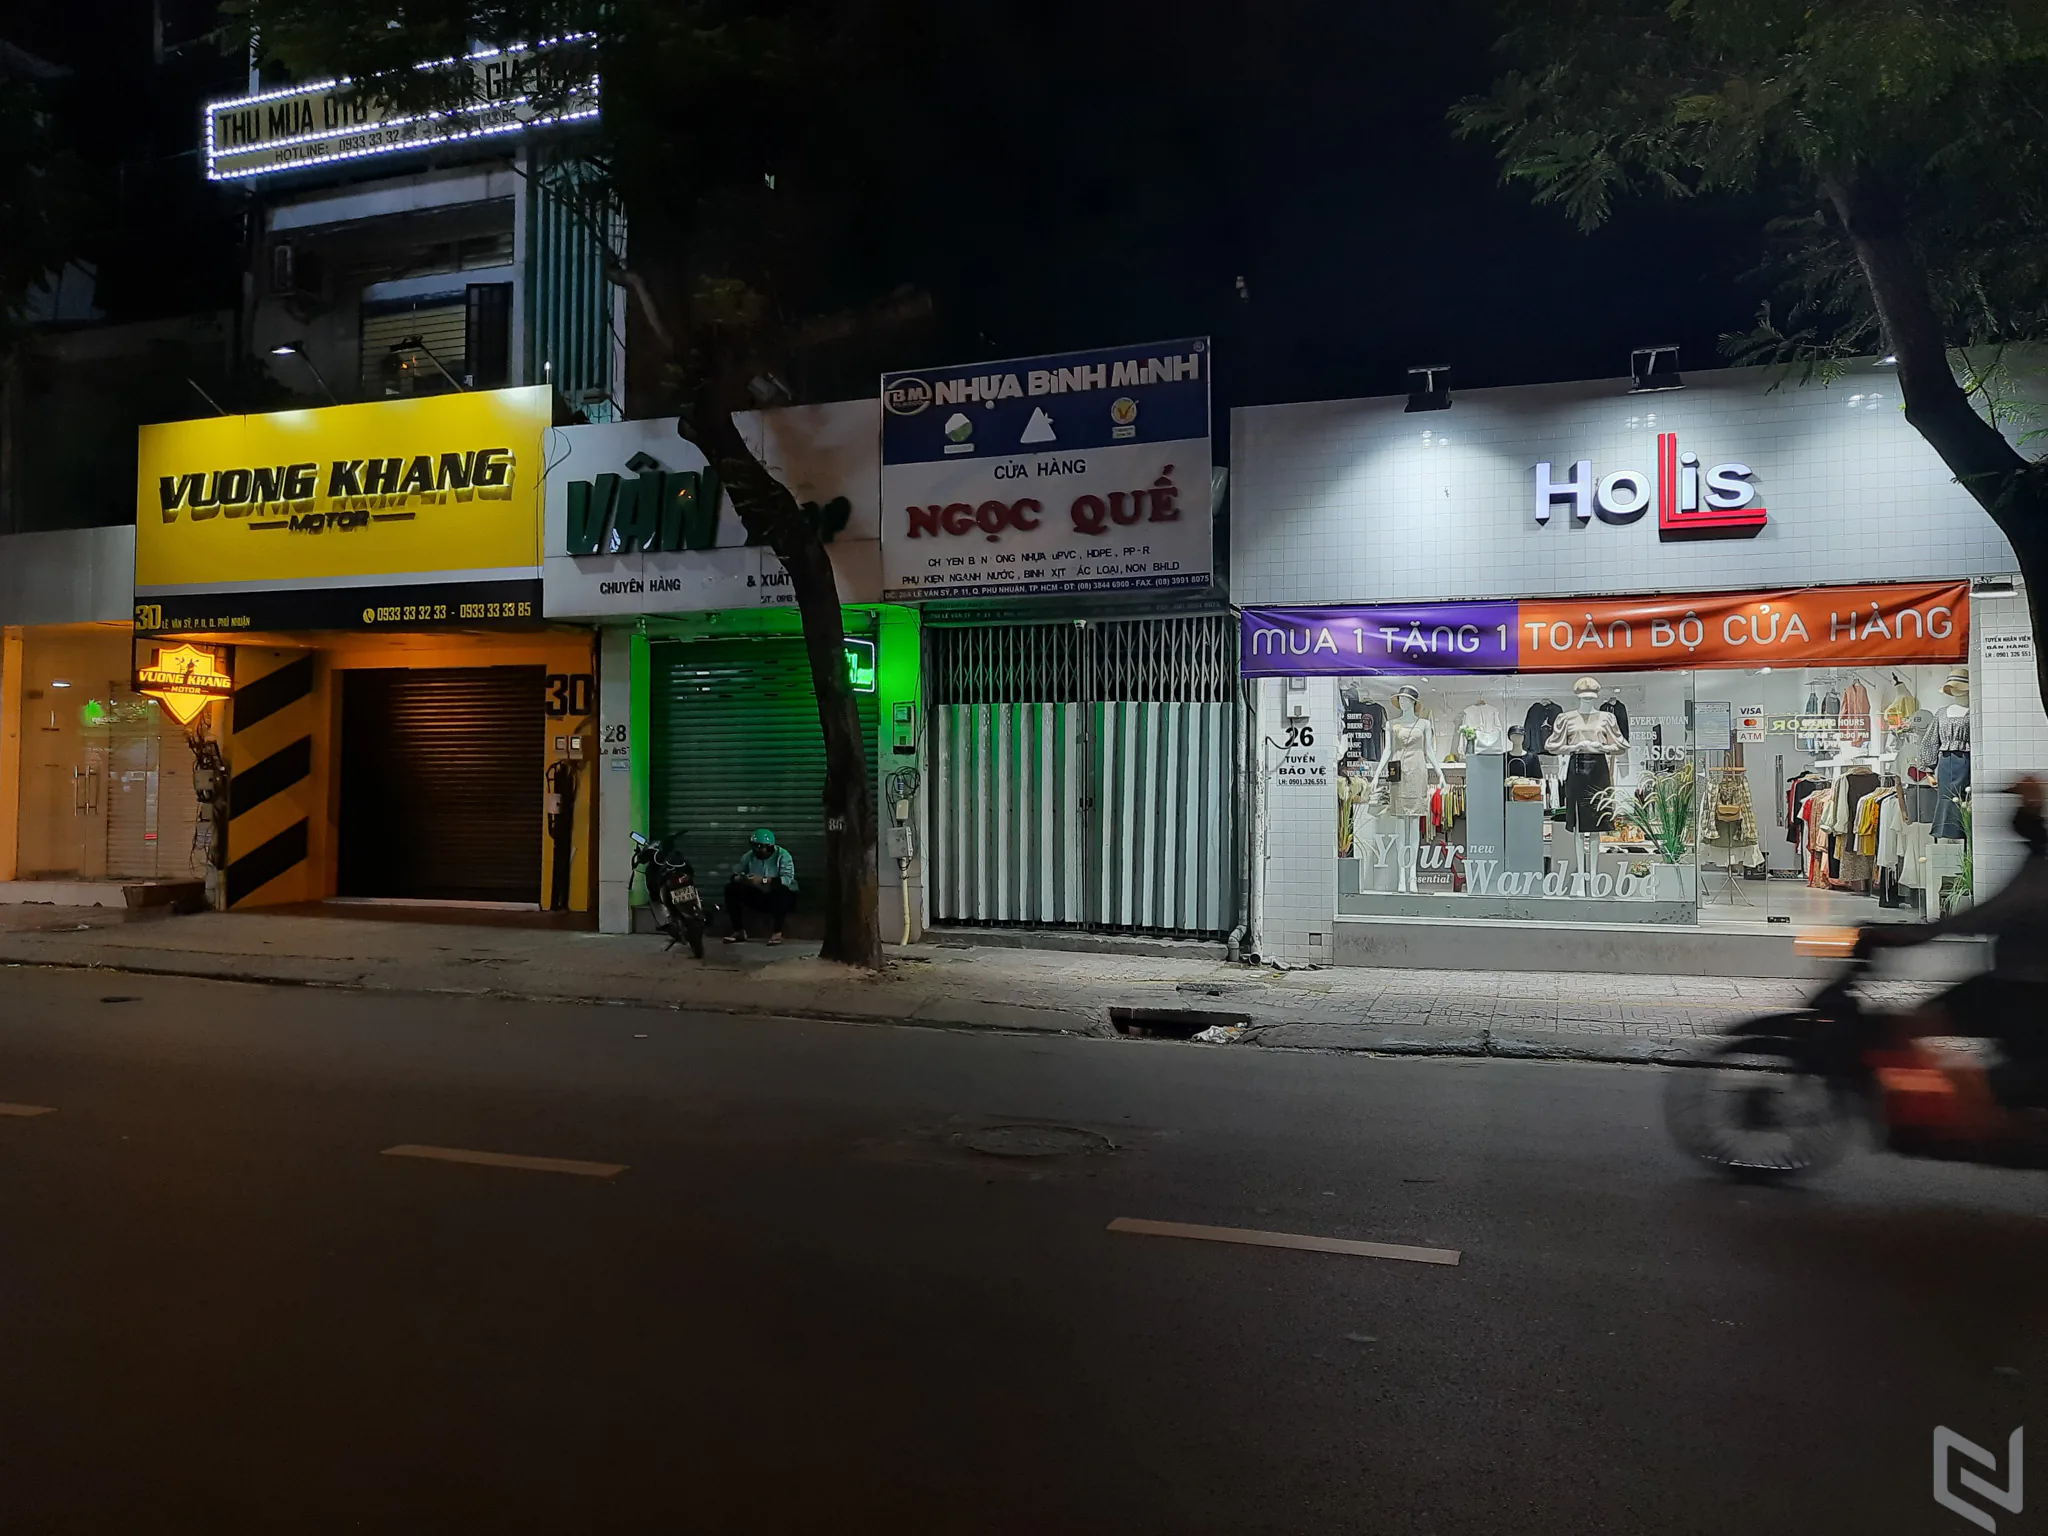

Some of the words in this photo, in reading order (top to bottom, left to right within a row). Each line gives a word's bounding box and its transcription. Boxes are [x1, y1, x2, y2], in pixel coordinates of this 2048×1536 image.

[219, 109, 260, 148] THU
[268, 99, 314, 139] MUA
[275, 143, 329, 162] HOTLINE:
[339, 135, 365, 151] 0933
[369, 134, 382, 147] 33
[993, 459, 1029, 480] CỬA
[1037, 458, 1087, 477] HÀNG
[159, 462, 318, 513] VUONG
[327, 448, 514, 502] KHANG
[905, 498, 1042, 543] NGỌC
[1070, 464, 1181, 536] QUẾ
[288, 510, 370, 532] MOTOR
[600, 576, 644, 594] CHUYÊN
[650, 575, 681, 592] HÀNG
[902, 575, 920, 586] PHỤ
[1041, 583, 1058, 592] HCM
[135, 604, 162, 630] 30
[377, 606, 400, 621] 0933
[403, 605, 416, 621] 33
[418, 605, 430, 620] 32
[433, 604, 446, 619] 33
[460, 603, 484, 618] 0933
[487, 602, 500, 617] 33
[502, 602, 515, 617] 33
[518, 601, 531, 617] 85
[1353, 627, 1363, 654] 1
[1379, 620, 1480, 659] TẶNG
[1496, 624, 1507, 652] 1
[1525, 612, 1632, 651] TOÀN
[1650, 609, 1704, 652] BỘ
[1723, 604, 1809, 646] CỬA
[1830, 600, 1953, 642] HÀNG
[138, 670, 184, 684] VUONG
[187, 673, 232, 689] KHANG
[171, 685, 201, 694] MOTOR
[545, 674, 593, 716] 30
[1629, 716, 1659, 726] EVERY
[1659, 715, 1689, 725] WOMAN
[1740, 707, 1762, 715] VISA
[1838, 718, 1865, 726] HOURS
[604, 724, 627, 743] 28
[1285, 726, 1314, 748] 26
[1629, 731, 1658, 741] NEEDS
[1740, 732, 1762, 740] ATM
[1285, 752, 1316, 763] TUYỂN
[1279, 765, 1306, 775] BẢO
[1310, 765, 1327, 776] VỆ
[1373, 833, 1464, 869] Your
[1469, 843, 1495, 854] new
[1461, 859, 1660, 898] Wardrobe
